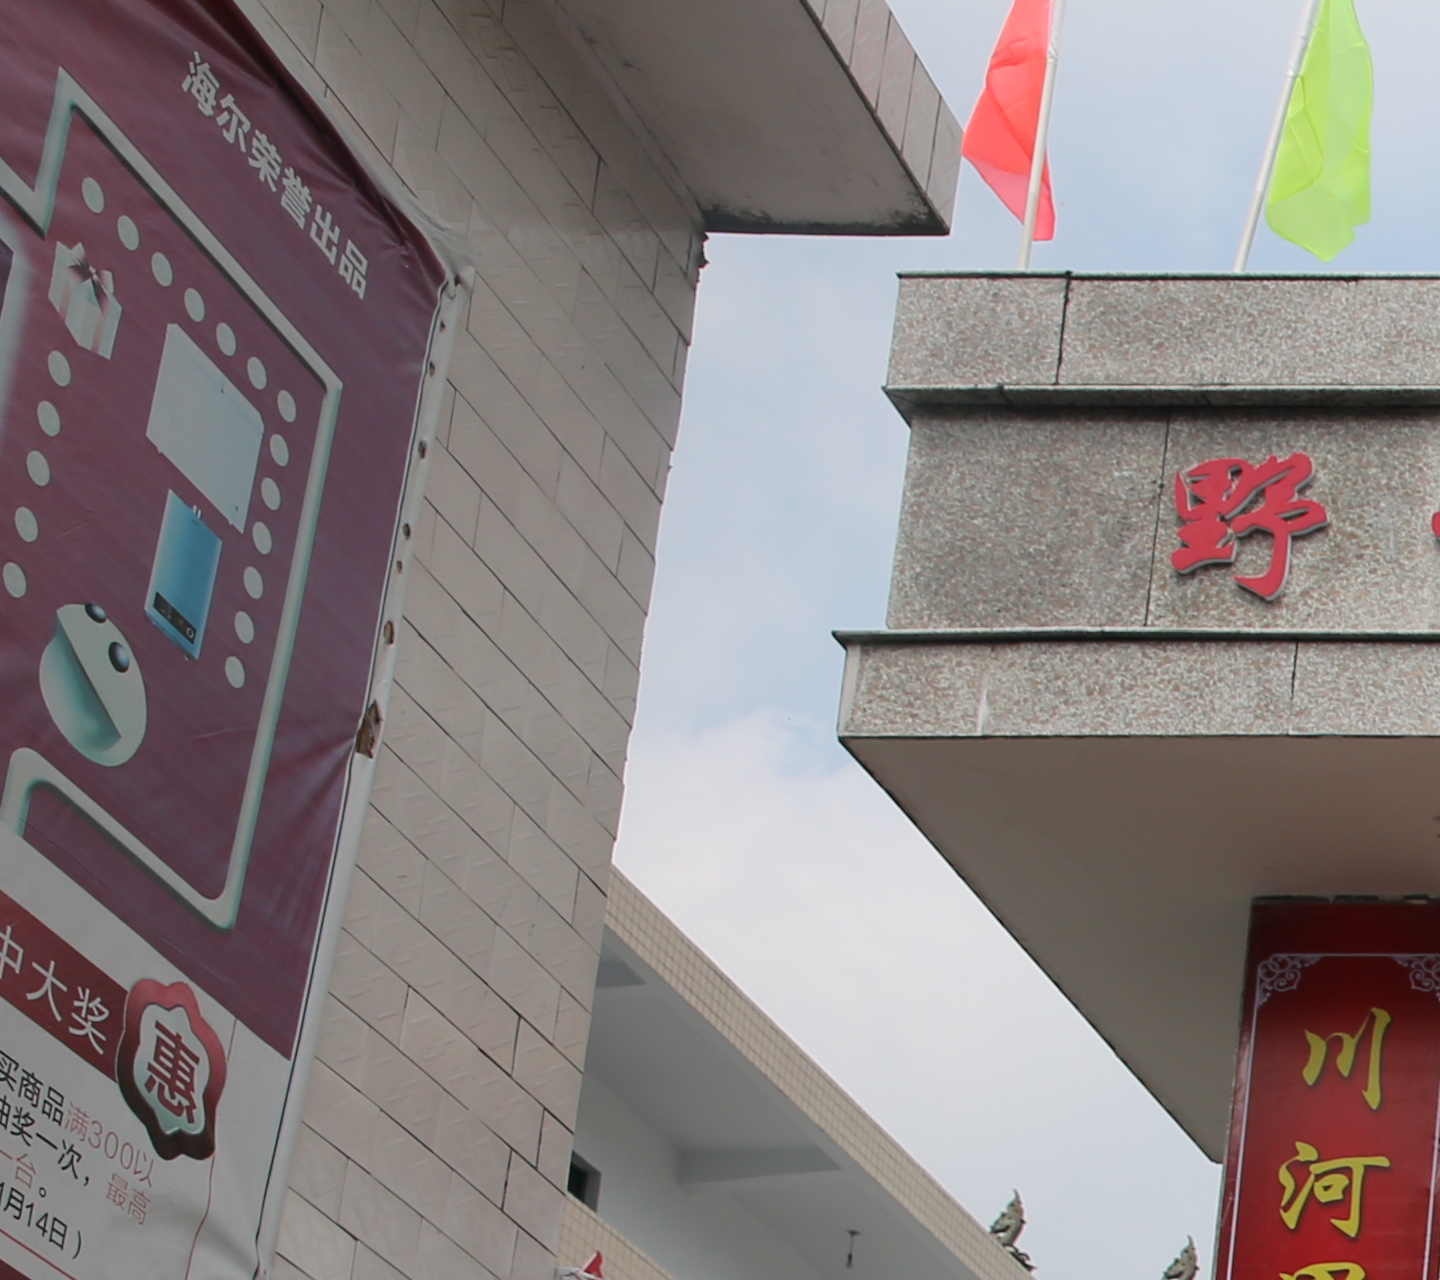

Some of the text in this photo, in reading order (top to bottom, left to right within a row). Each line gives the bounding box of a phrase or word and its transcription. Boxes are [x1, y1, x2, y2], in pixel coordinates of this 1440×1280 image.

[182, 51, 368, 301] 海尔荣誉出品
[142, 1019, 201, 1125] 惠
